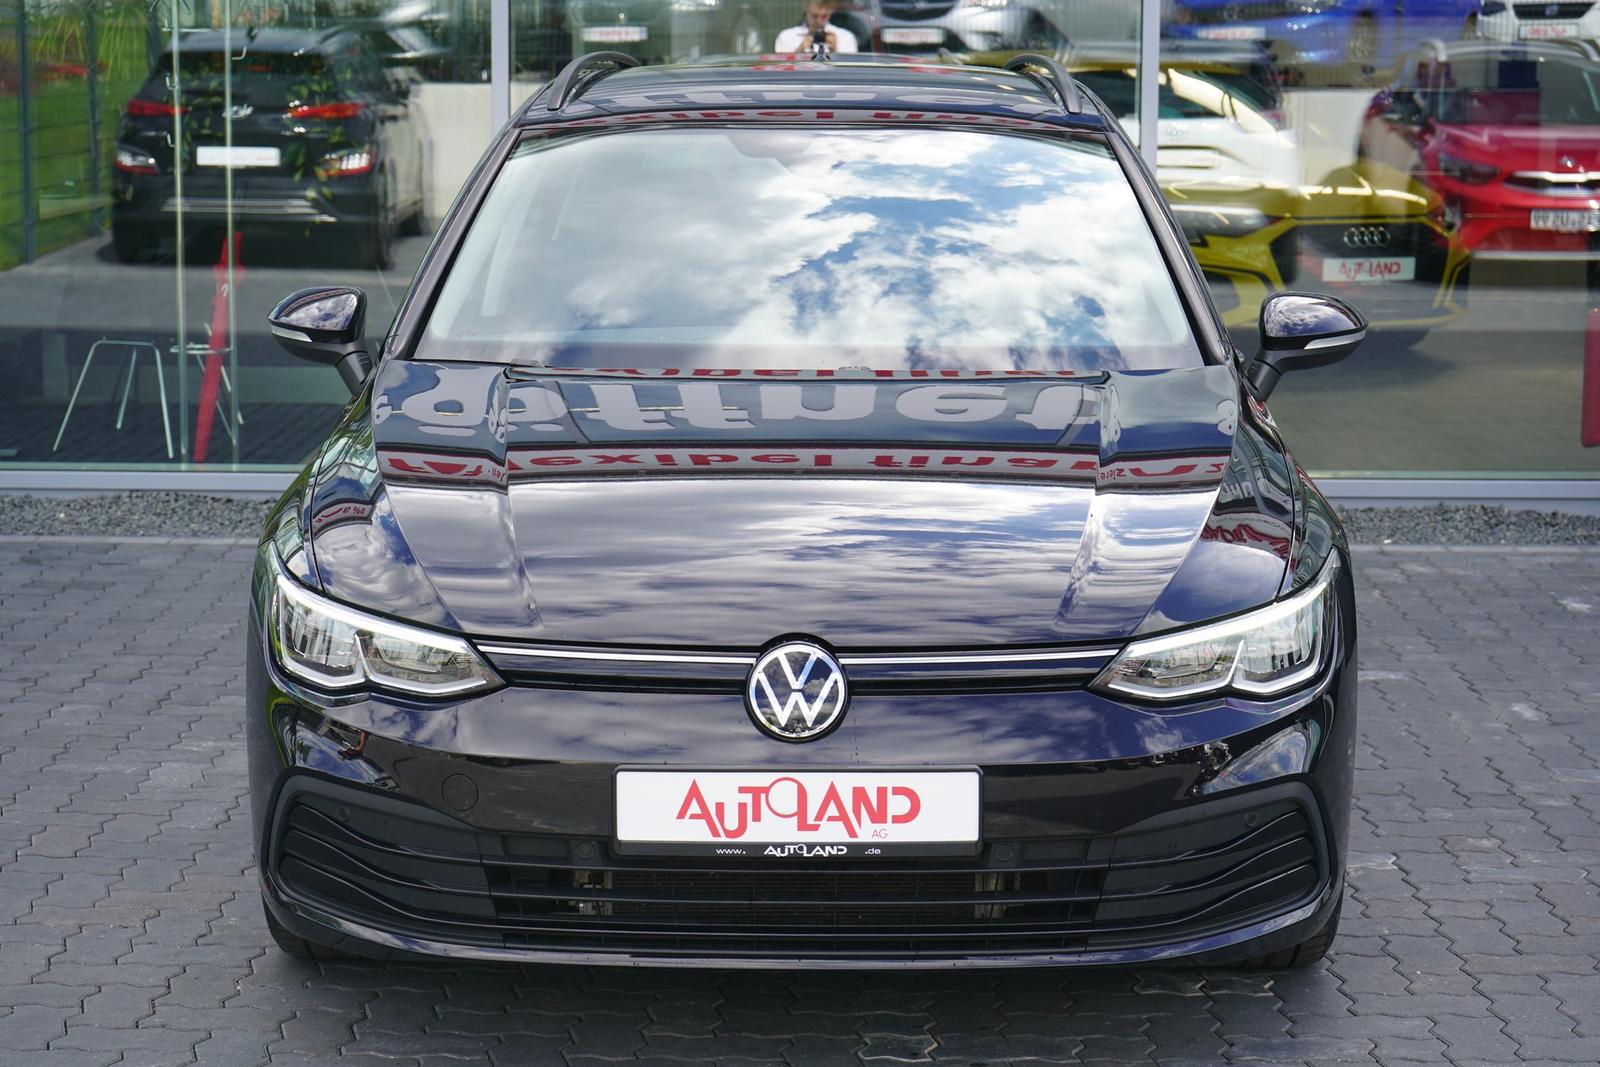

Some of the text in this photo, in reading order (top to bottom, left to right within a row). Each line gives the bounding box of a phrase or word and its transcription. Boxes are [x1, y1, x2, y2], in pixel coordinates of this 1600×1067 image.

[676, 776, 921, 839] AUTOLAND
[871, 828, 888, 839] AG
[763, 843, 848, 858] AUTOLAND
[864, 847, 882, 855] .de
